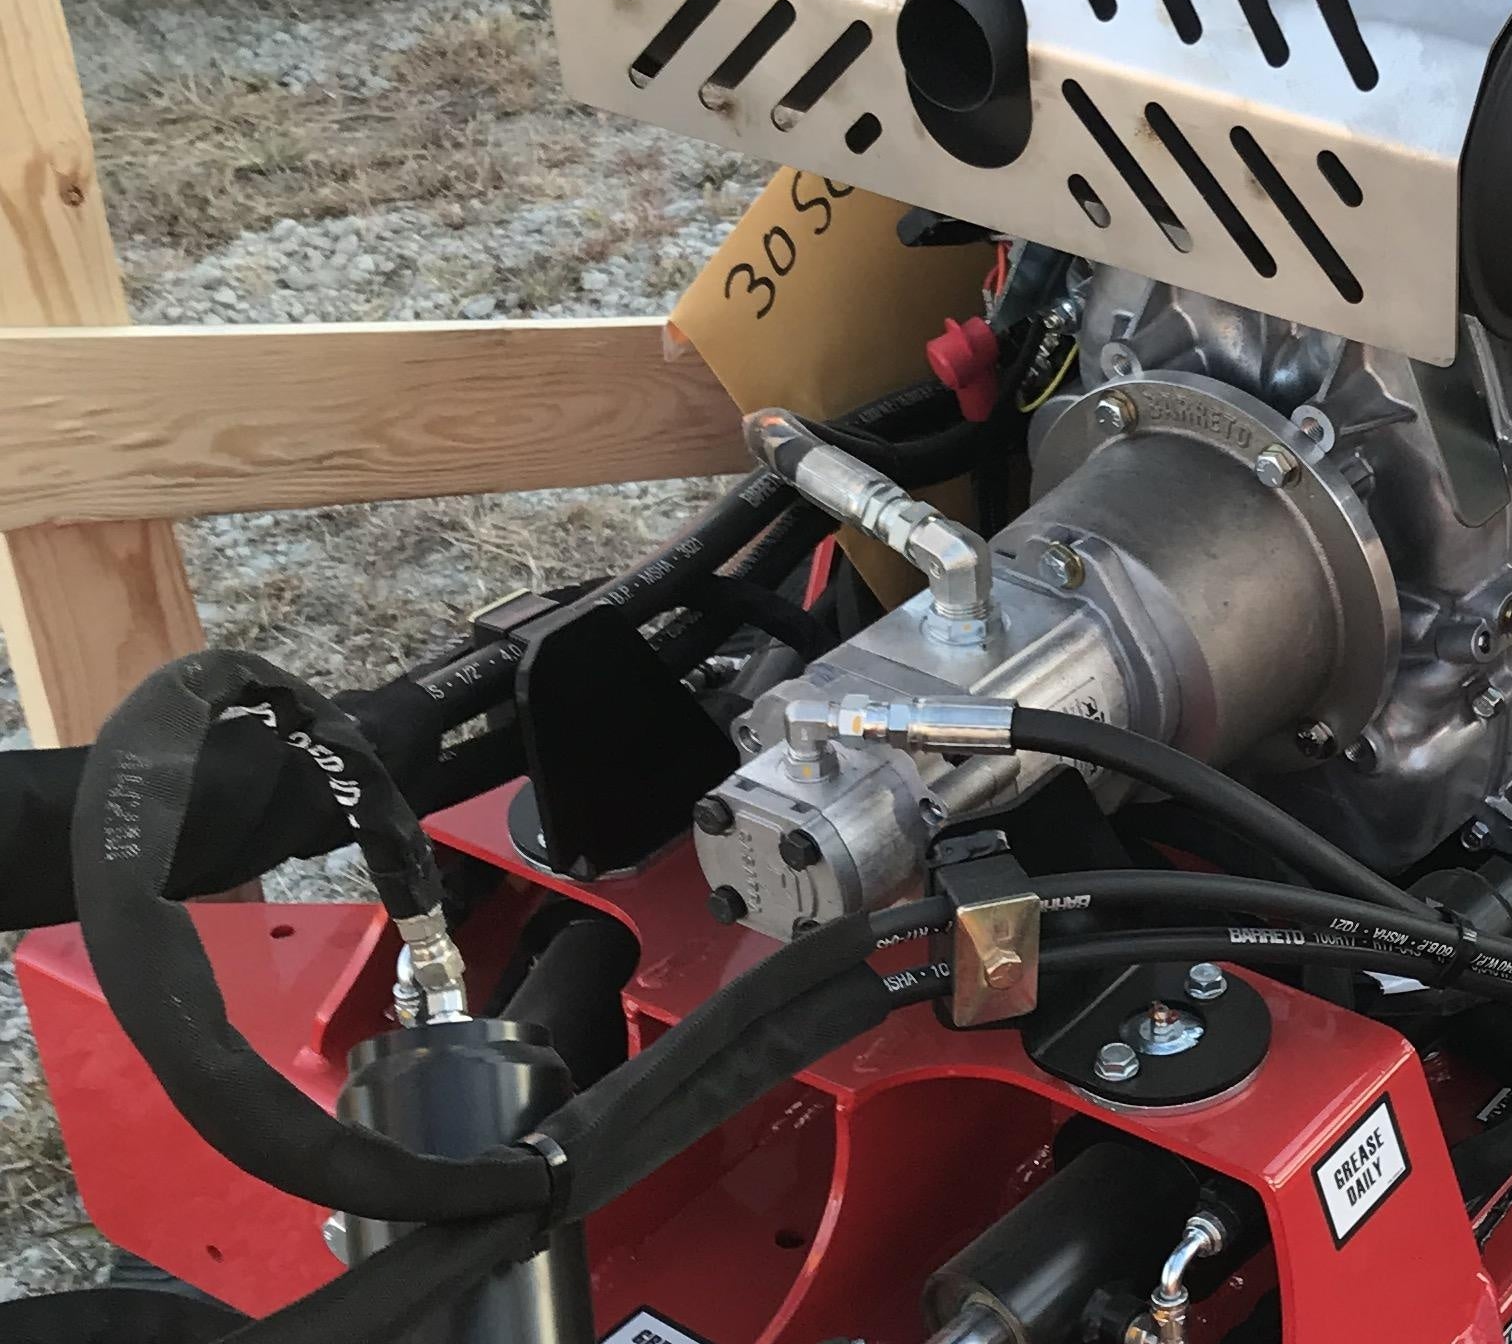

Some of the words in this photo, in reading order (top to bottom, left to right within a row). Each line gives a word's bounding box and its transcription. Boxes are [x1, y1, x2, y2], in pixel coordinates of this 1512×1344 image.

[1228, 927, 1305, 945] BARRETO
[1333, 1126, 1384, 1190] GREASE
[1346, 1156, 1383, 1207] DAILY
